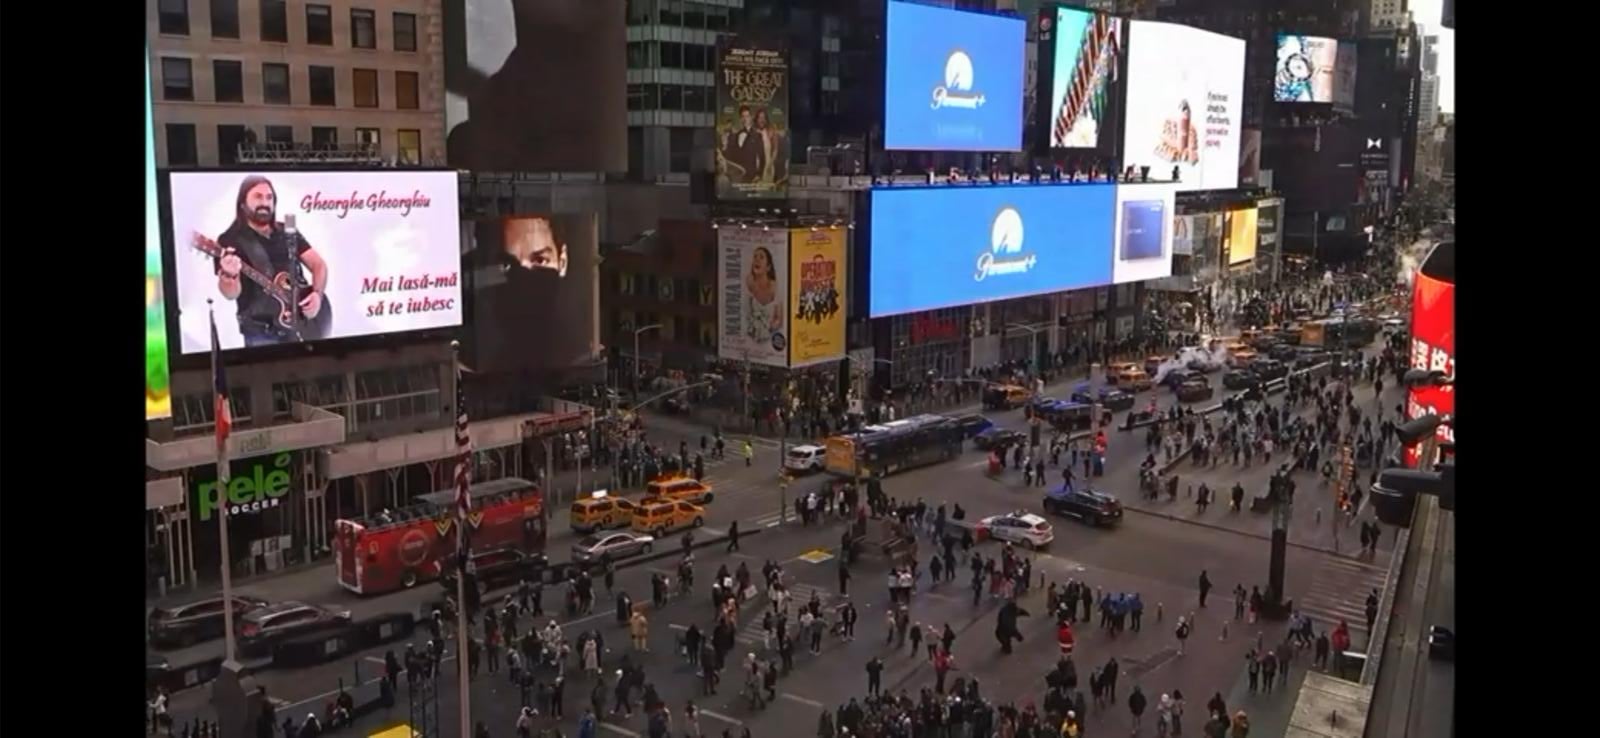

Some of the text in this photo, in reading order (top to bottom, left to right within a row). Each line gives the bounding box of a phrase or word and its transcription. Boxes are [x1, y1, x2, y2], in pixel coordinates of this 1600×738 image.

[724, 68, 785, 87] THE GREAT
[730, 85, 777, 102] GATSBY
[300, 190, 431, 219] Gheorghe Gheorghiu
[360, 272, 458, 295] Mai lasă-mă
[725, 248, 742, 336] MAMMA MIA!
[366, 297, 455, 318] să te iubesc
